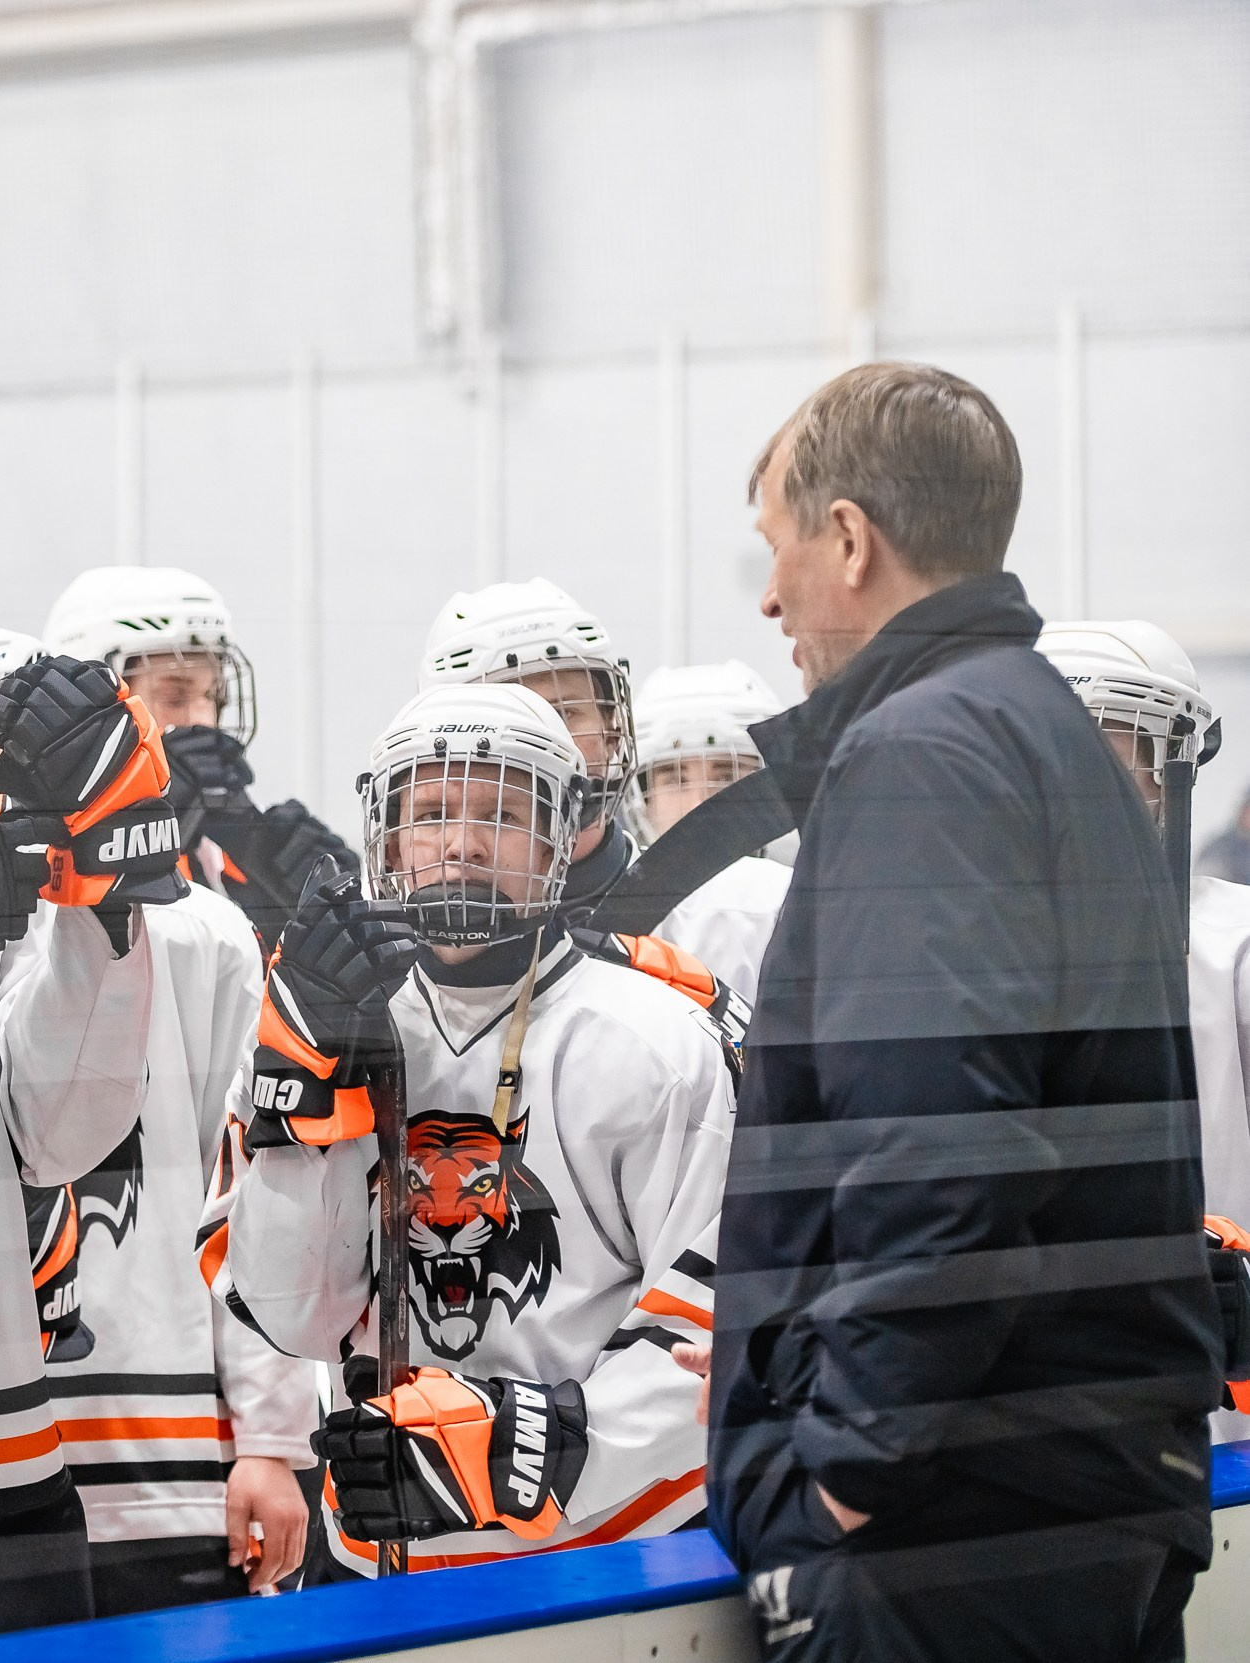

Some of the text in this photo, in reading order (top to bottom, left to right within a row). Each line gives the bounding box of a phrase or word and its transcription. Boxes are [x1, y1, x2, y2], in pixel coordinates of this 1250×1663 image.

[427, 929, 491, 940] EASTON
[253, 1074, 304, 1111] СШ
[507, 1382, 548, 1509] АМУР
